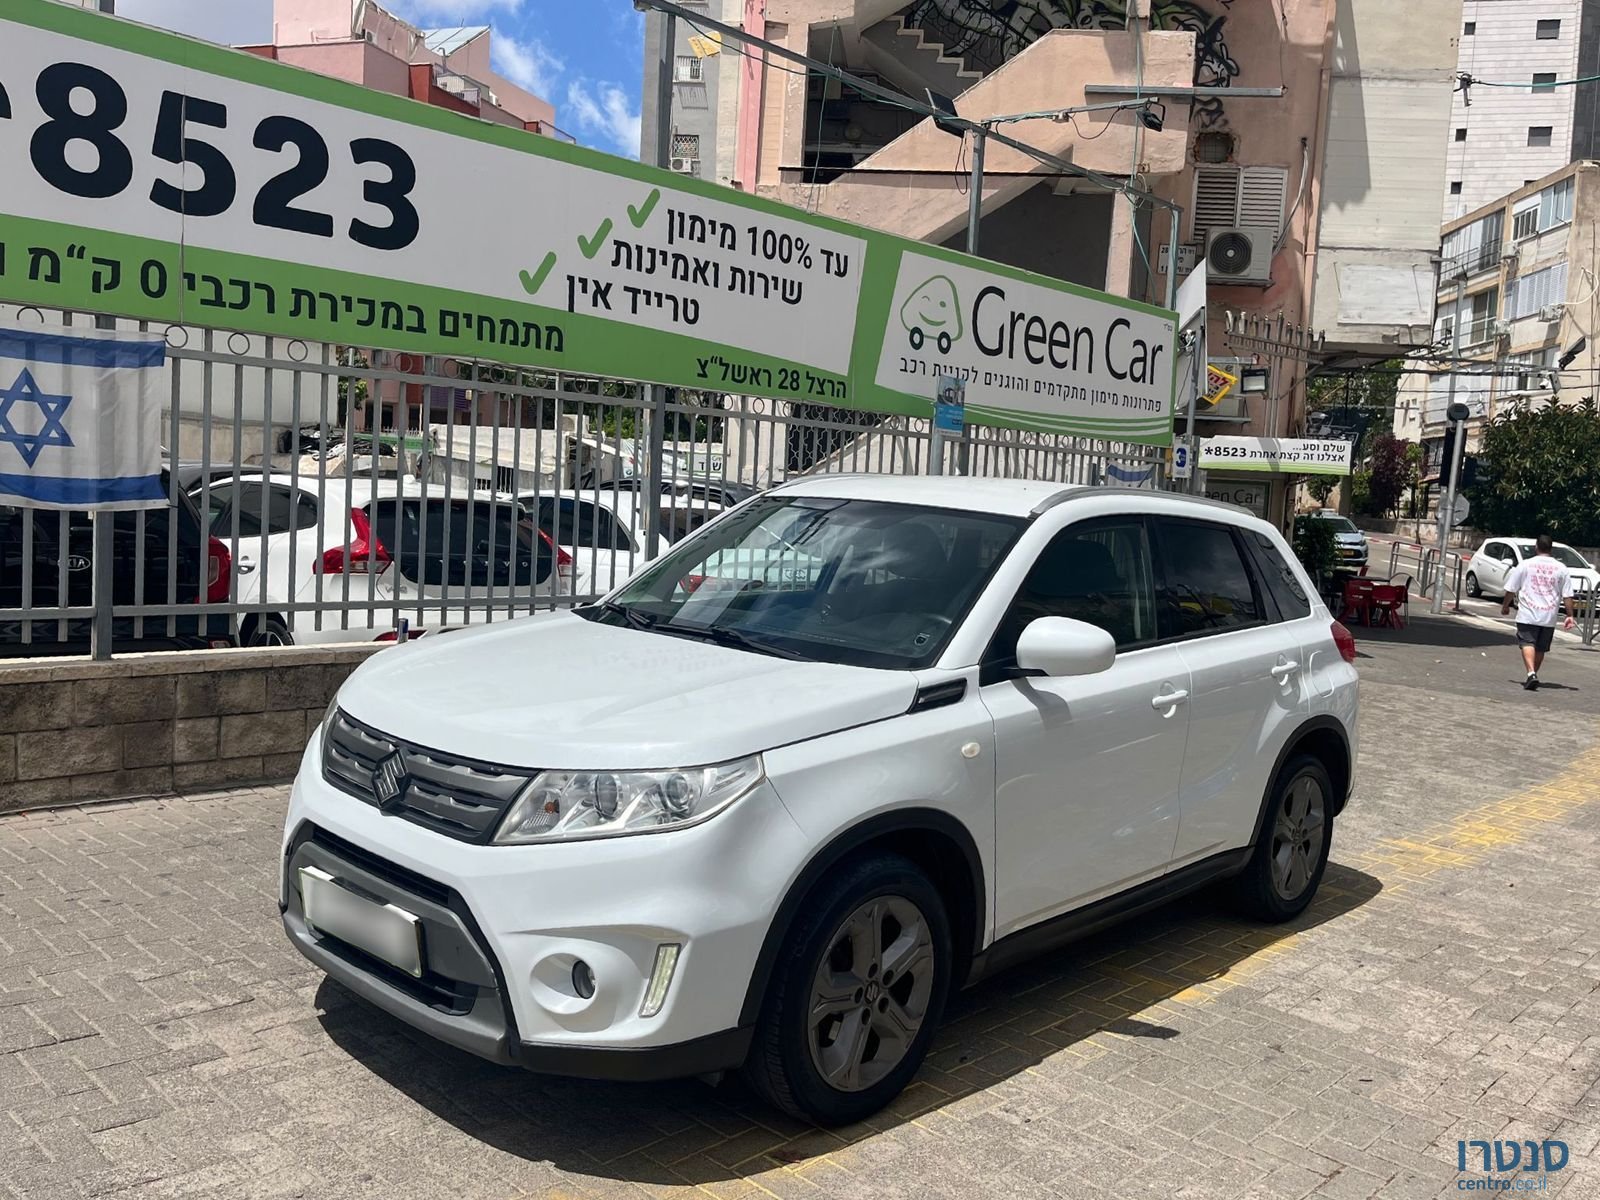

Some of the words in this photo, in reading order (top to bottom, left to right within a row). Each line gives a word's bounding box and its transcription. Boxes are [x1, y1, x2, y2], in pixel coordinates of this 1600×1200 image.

[0, 61, 419, 251] 8523
[667, 208, 736, 251] מימון
[747, 226, 813, 269] 100%
[611, 239, 719, 288] ואמינות
[820, 248, 848, 278] עד
[140, 259, 168, 299] 0
[183, 272, 275, 314] רכבי
[566, 274, 613, 313] אין
[728, 266, 803, 305] שירות
[290, 287, 427, 334] במכירת
[623, 285, 700, 325] טרייד
[439, 309, 564, 353] מתמחים
[971, 285, 1094, 374] Green
[1104, 317, 1163, 385] Car
[696, 355, 772, 389] ראשל"צ
[777, 367, 800, 391] 28
[899, 357, 926, 376] רכב
[984, 371, 1029, 392] והוגנים
[805, 370, 848, 399] הרצל
[1033, 380, 1086, 402] מתקדמים
[1091, 389, 1119, 406] מימון
[1122, 394, 1162, 413] פתרונות
[1249, 450, 1277, 459] אחרת
[1279, 451, 1300, 462] קצת
[1303, 453, 1313, 461] זה
[1317, 452, 1345, 462] אצלנו
[1323, 443, 1345, 453] שלם
[1234, 489, 1260, 504] Car
